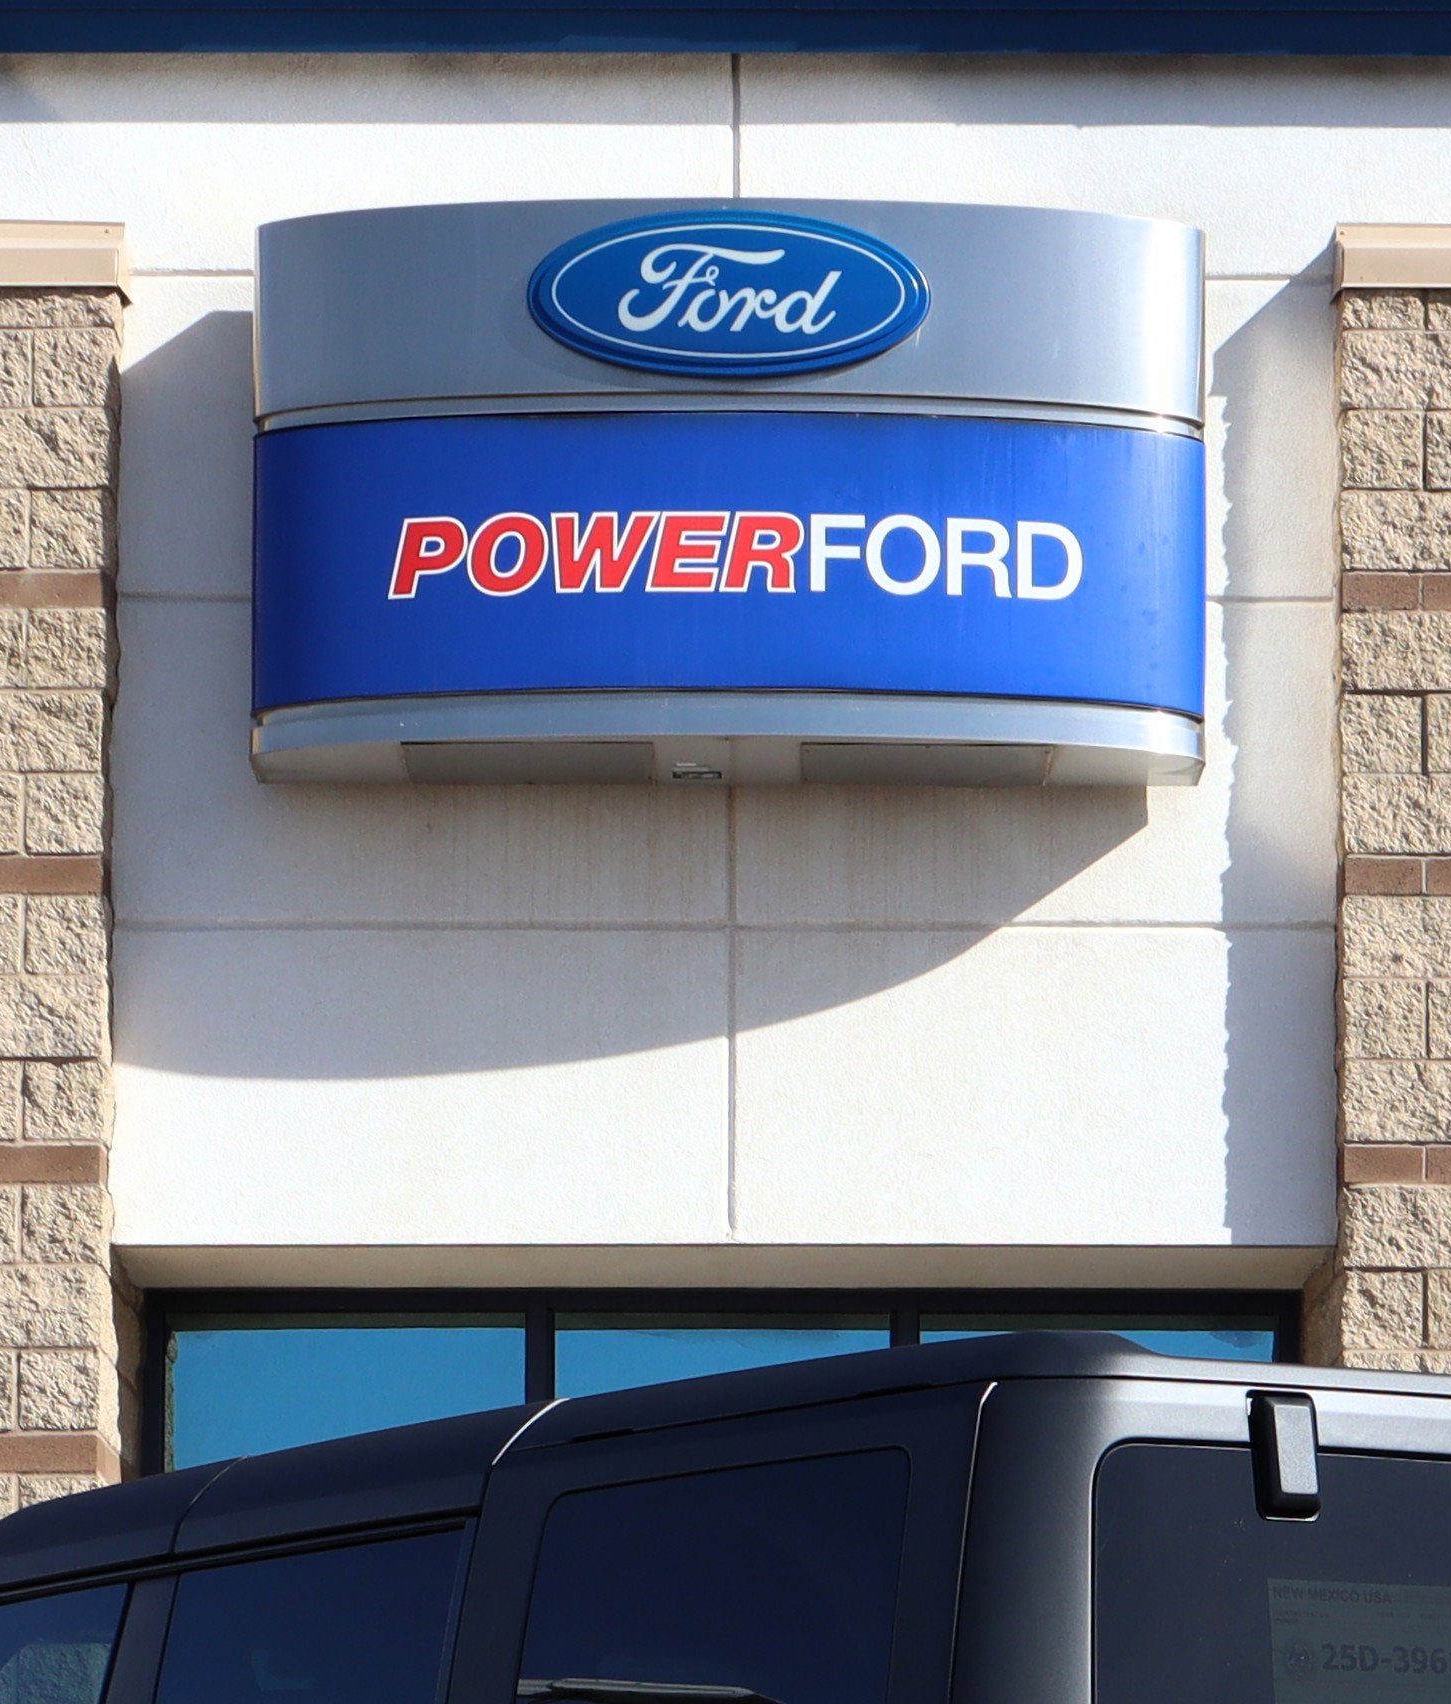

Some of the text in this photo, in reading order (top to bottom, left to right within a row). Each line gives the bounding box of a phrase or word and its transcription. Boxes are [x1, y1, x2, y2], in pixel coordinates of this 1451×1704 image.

[617, 243, 841, 339] Ford
[387, 509, 1085, 602] POWERFORD
[1272, 1585, 1393, 1605] NEW MEXICO USA
